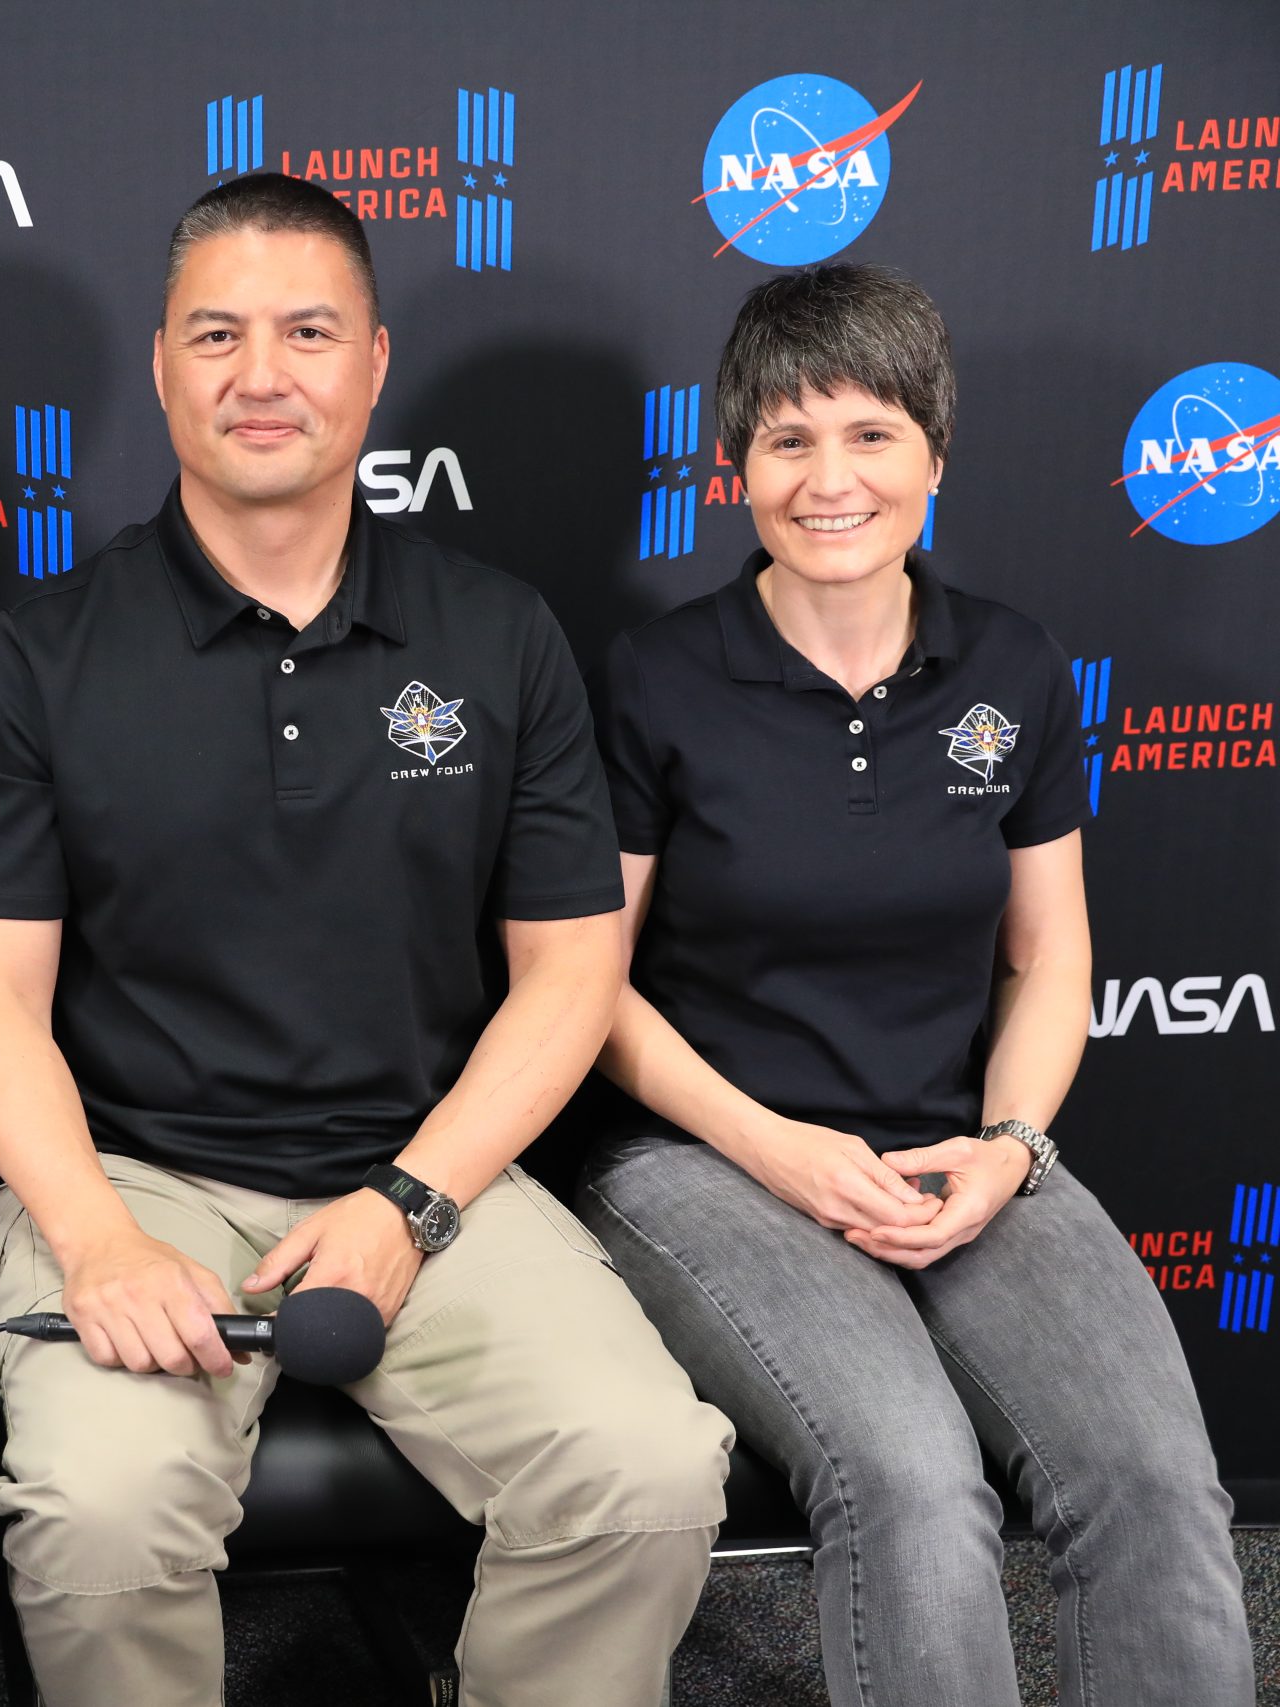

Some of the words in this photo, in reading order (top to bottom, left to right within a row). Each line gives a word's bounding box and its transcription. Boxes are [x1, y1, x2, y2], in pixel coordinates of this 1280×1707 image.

[1175, 116, 1280, 151] LAUN
[282, 146, 439, 180] LAUNCH
[718, 150, 880, 191] NASA
[1161, 158, 1280, 193] AMER
[332, 186, 448, 221] RICA
[358, 447, 474, 514] SA
[1122, 702, 1274, 735] LAUNCH
[390, 768, 430, 780] CREW
[436, 763, 474, 776] FOUR
[1110, 739, 1277, 772] AMERICA
[947, 785, 985, 796] CREW
[985, 784, 1010, 793] OUR
[1122, 1230, 1213, 1258] NCH
